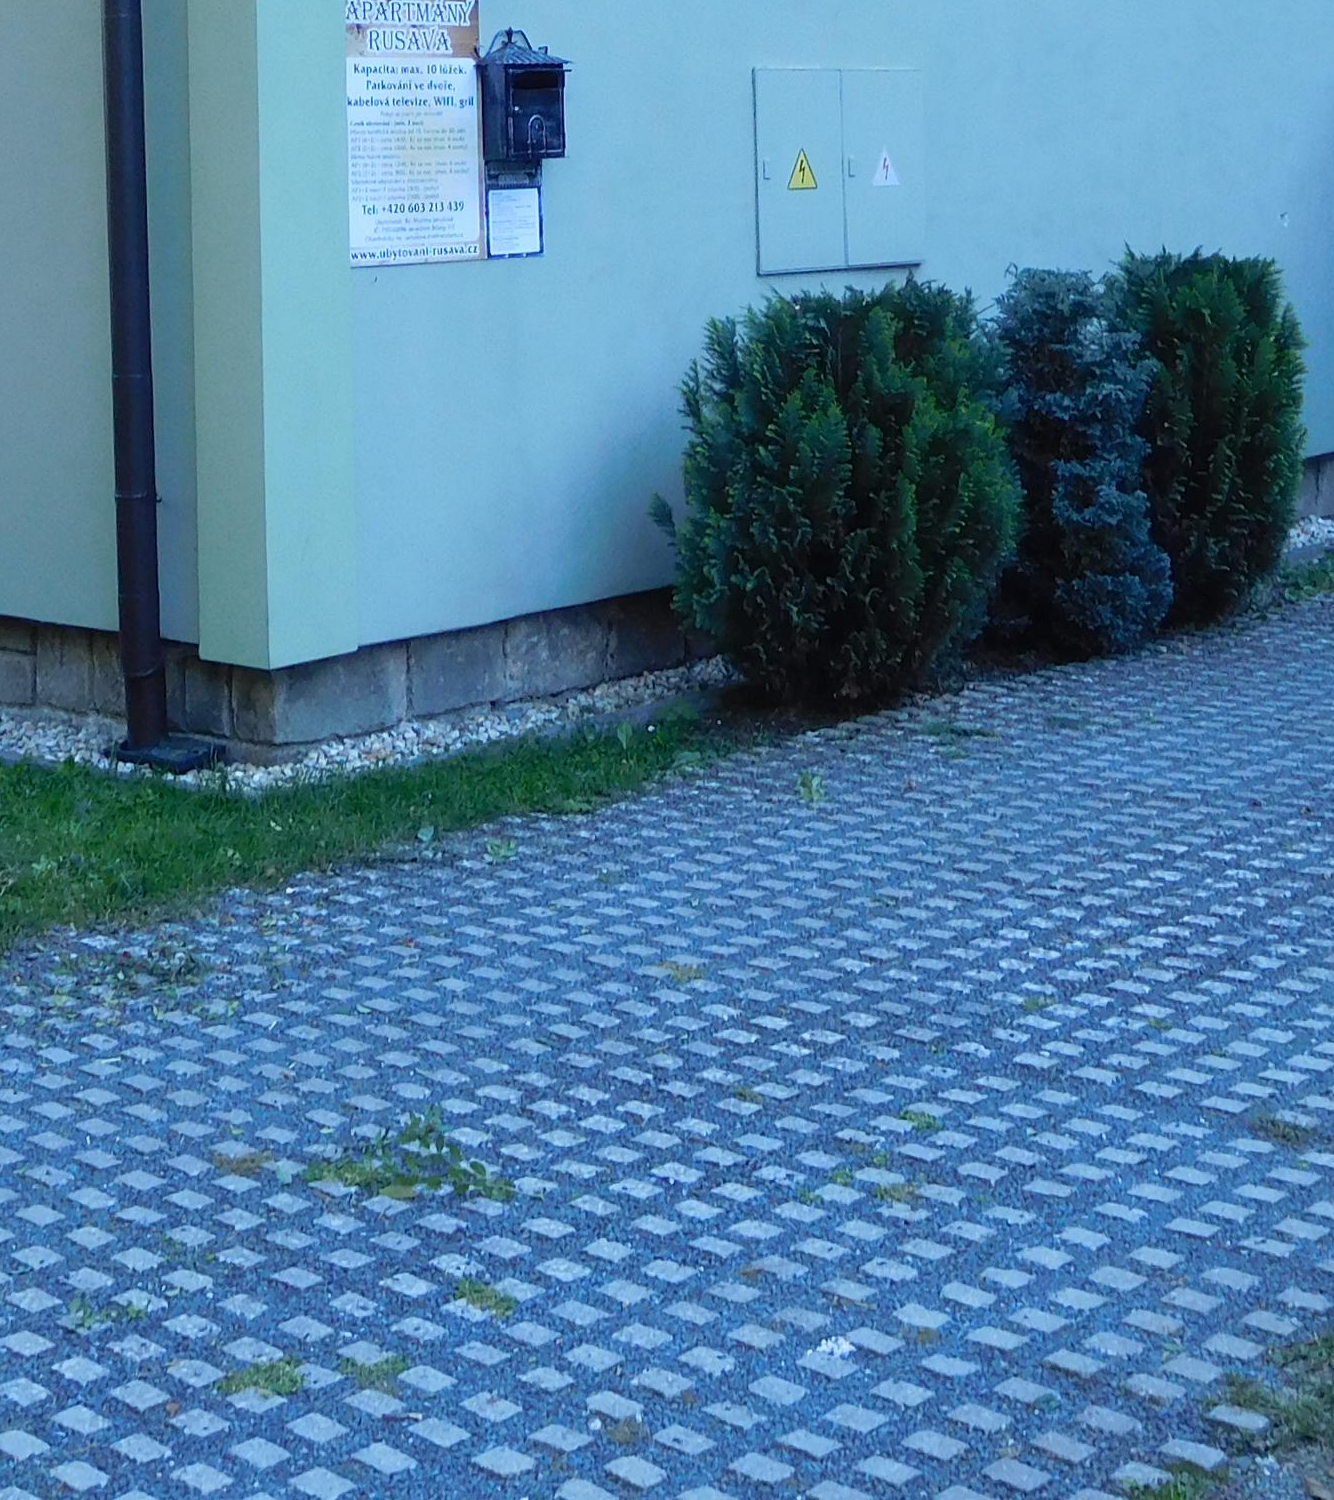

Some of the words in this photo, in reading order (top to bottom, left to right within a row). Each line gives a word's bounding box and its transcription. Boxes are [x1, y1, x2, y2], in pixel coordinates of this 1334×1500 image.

[368, 28, 450, 51] RUSAVA
[427, 64, 437, 74] 10
[408, 202, 426, 213] 603
